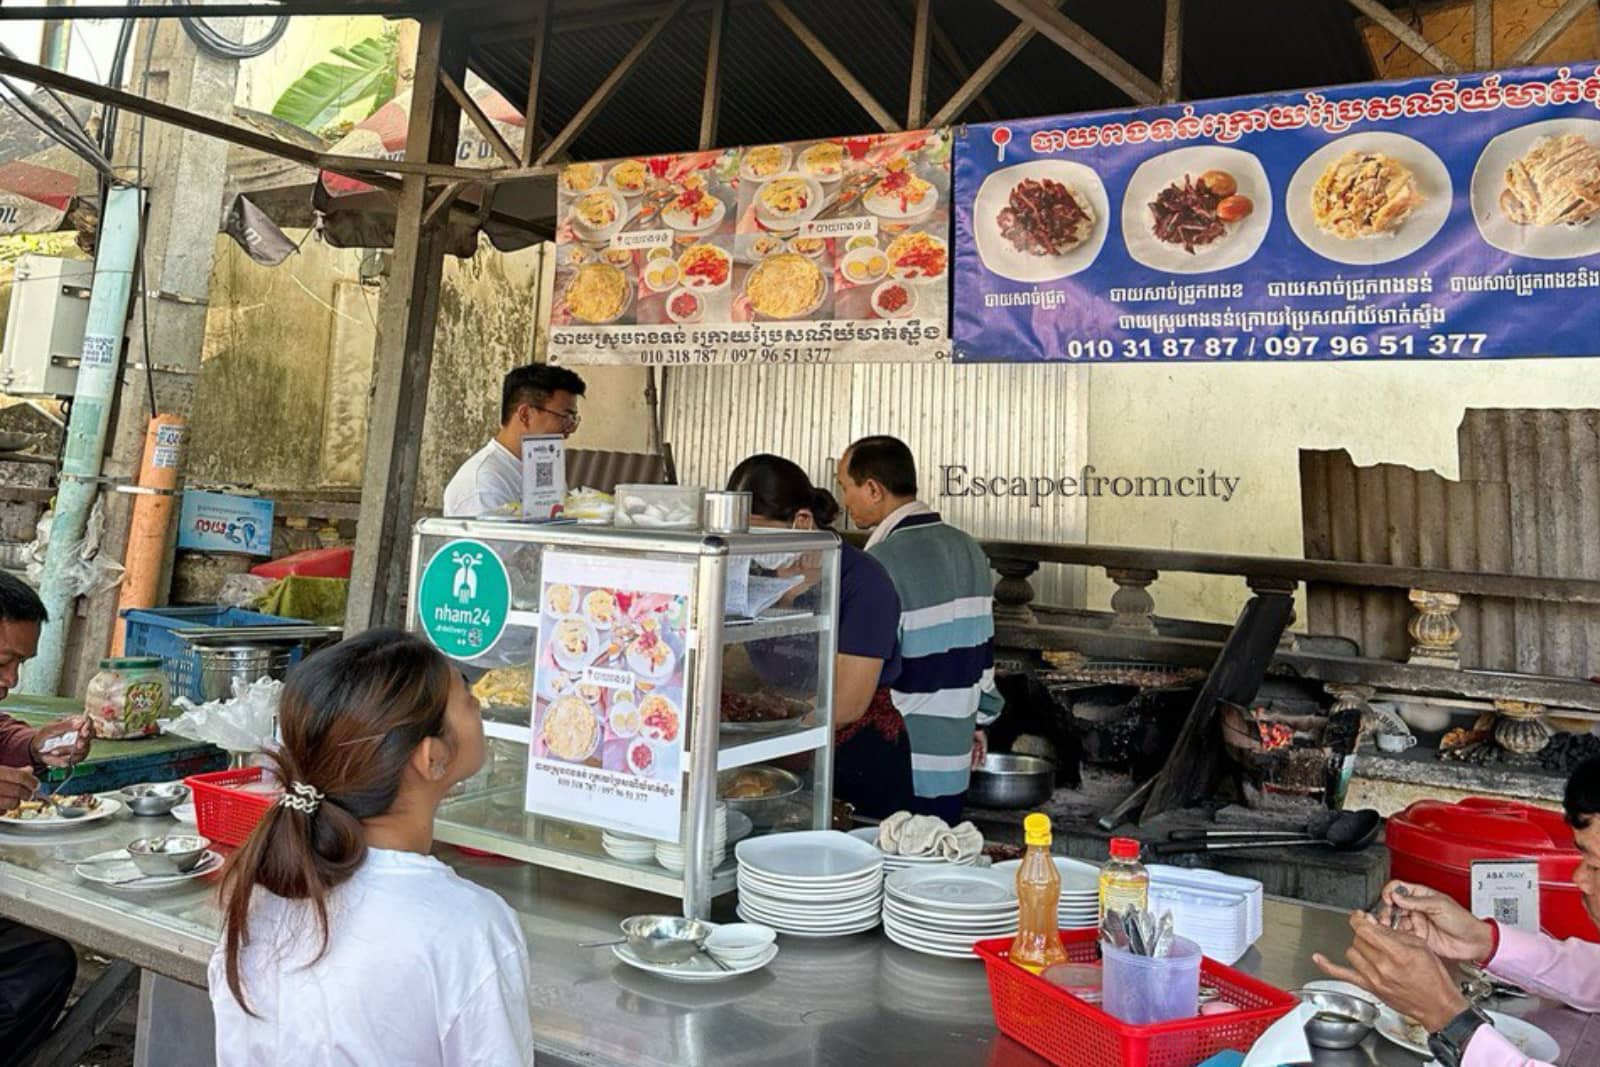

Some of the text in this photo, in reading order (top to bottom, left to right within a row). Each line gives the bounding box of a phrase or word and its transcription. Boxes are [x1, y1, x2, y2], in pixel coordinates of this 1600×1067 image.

[640, 351, 664, 364] 010
[666, 351, 690, 364] 318
[694, 349, 718, 363] 787
[731, 348, 757, 363] 097
[760, 348, 778, 363] 96
[782, 348, 799, 362] 51
[802, 347, 832, 362] 377
[1067, 333, 1488, 359] 010 31 87 87 / 097 96 51 377
[434, 603, 491, 627] nham24
